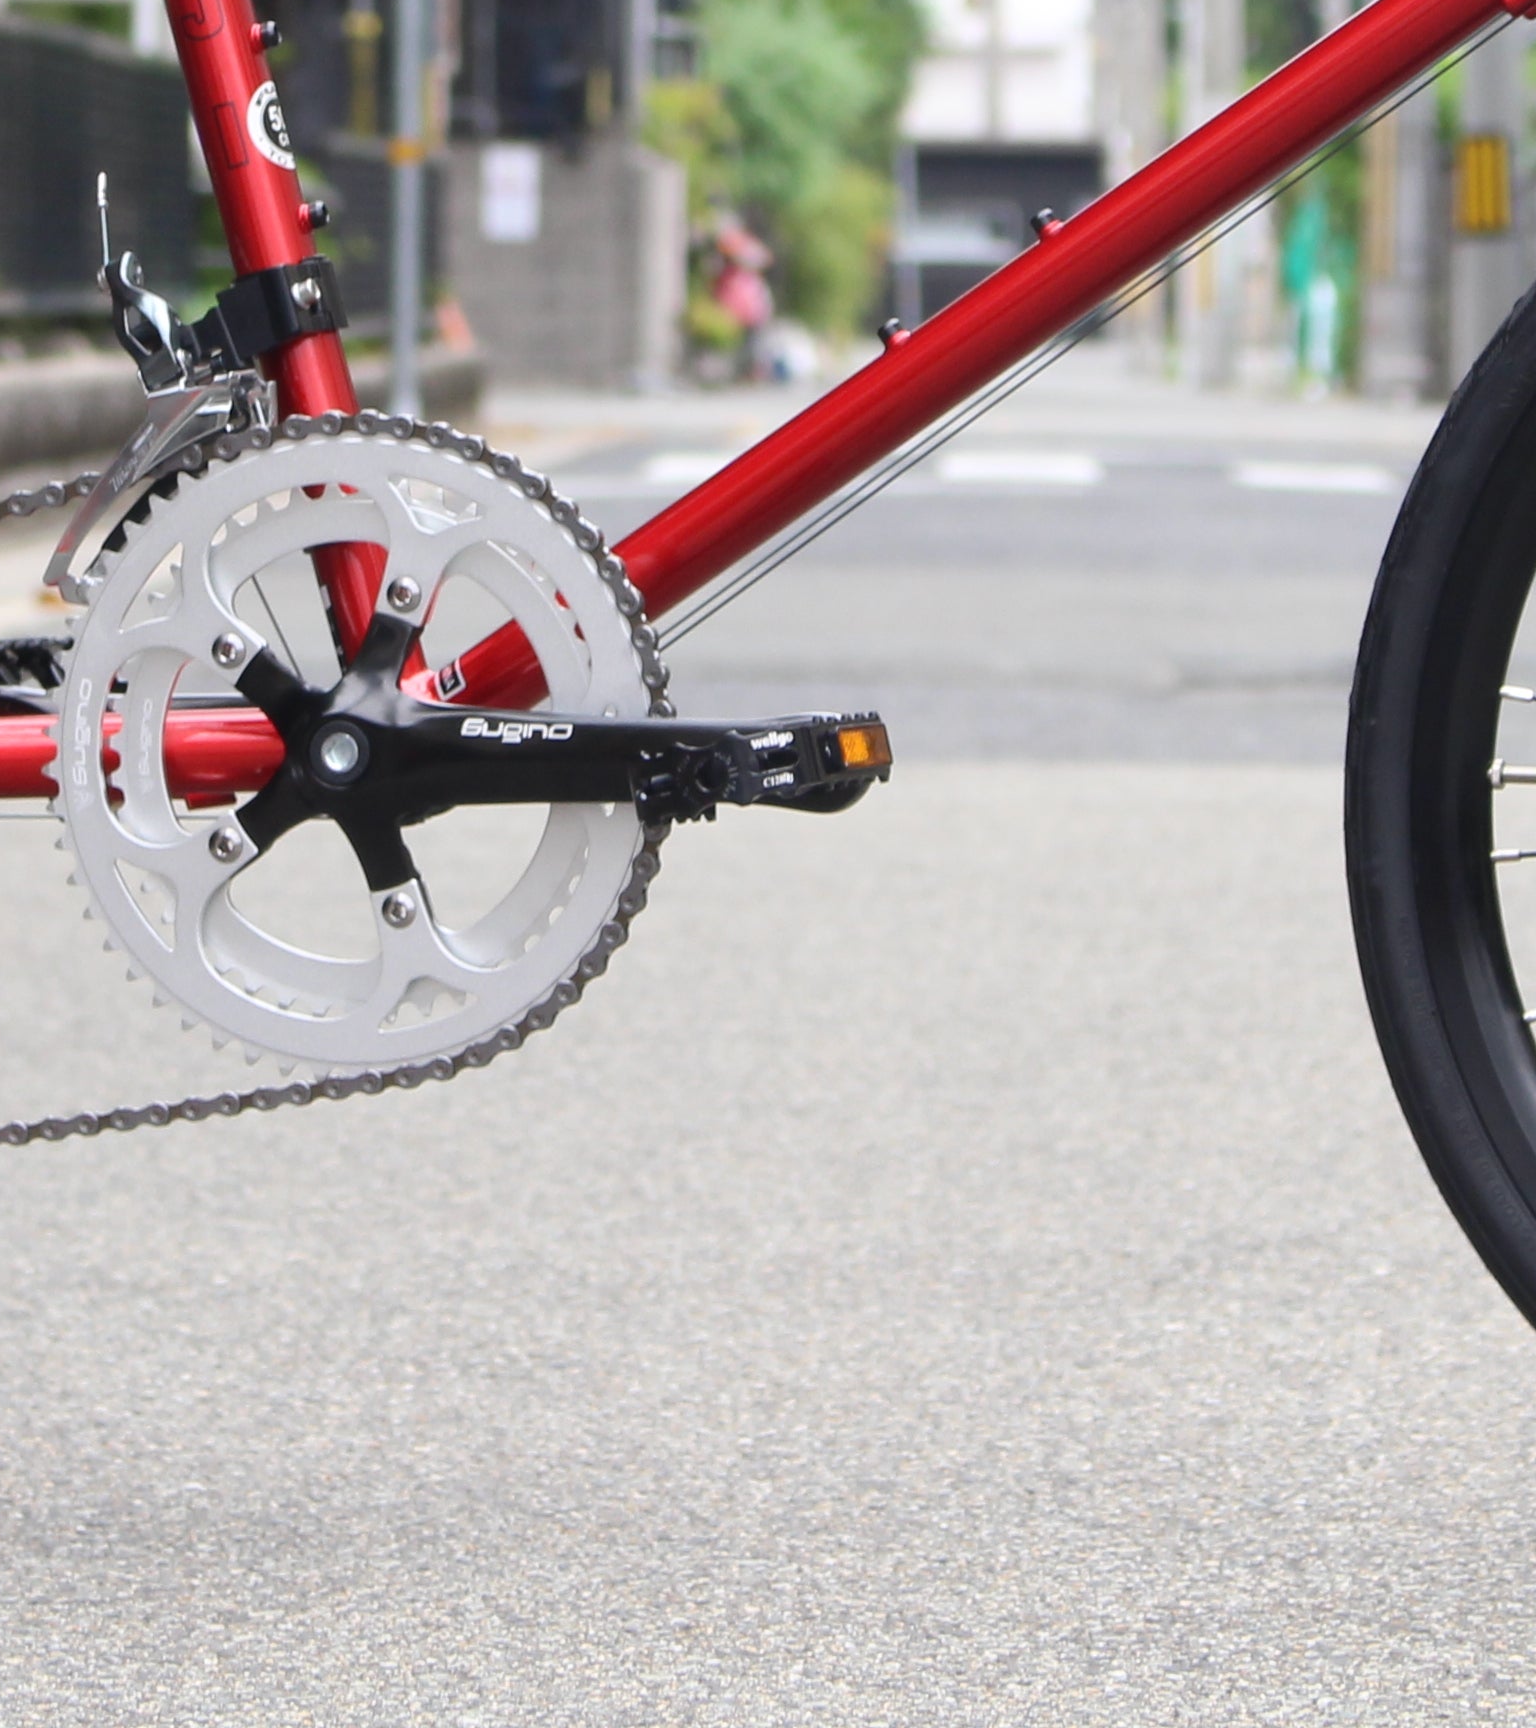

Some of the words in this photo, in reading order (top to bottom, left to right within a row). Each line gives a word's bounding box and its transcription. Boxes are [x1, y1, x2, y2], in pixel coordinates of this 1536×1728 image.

[72, 678, 93, 786] Sugino
[460, 717, 574, 744] Sugino
[750, 731, 794, 751] wellgo
